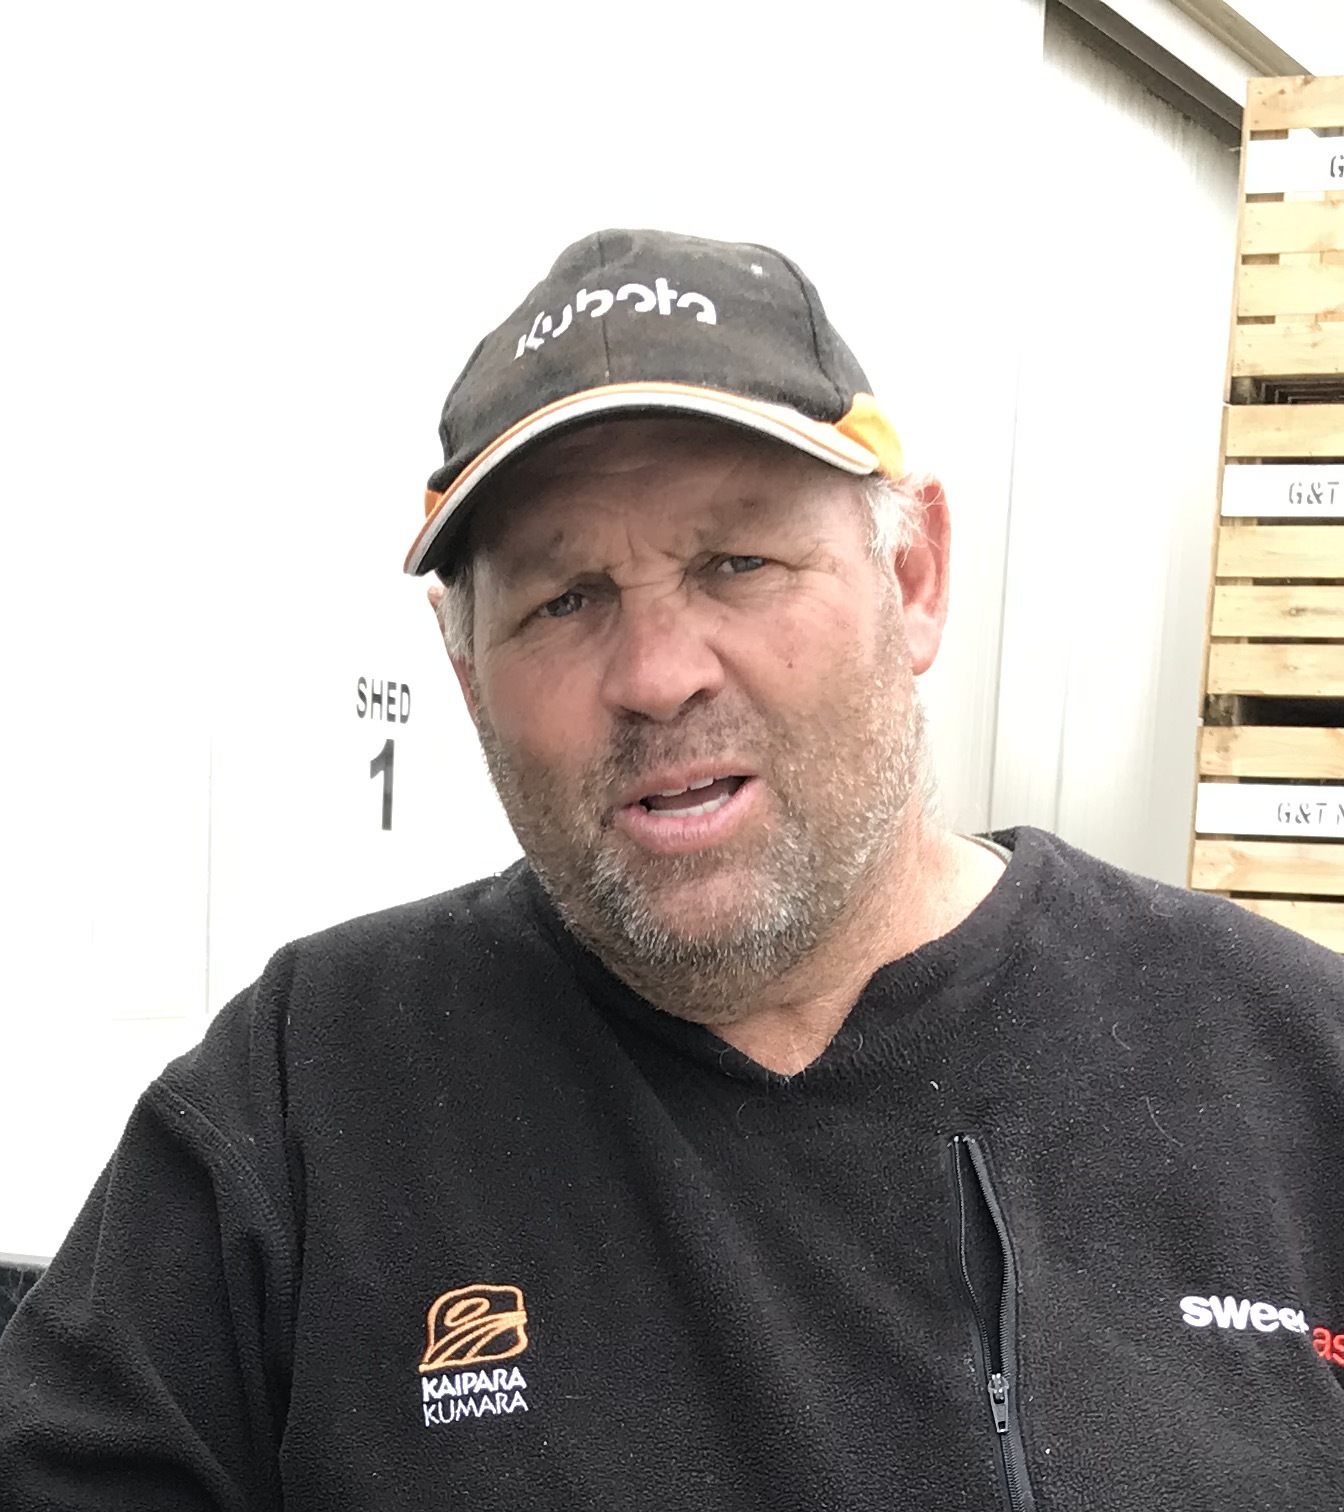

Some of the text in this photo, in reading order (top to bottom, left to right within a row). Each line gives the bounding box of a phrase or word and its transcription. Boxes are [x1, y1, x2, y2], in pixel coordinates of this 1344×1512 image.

[514, 277, 717, 359] Kubota
[1289, 481, 1339, 504] G&T
[357, 677, 410, 724] SHED
[370, 739, 395, 831] 1
[1278, 803, 1327, 824] G&T
[422, 1366, 528, 1402] KAIPARA
[423, 1390, 529, 1427] KUMARA
